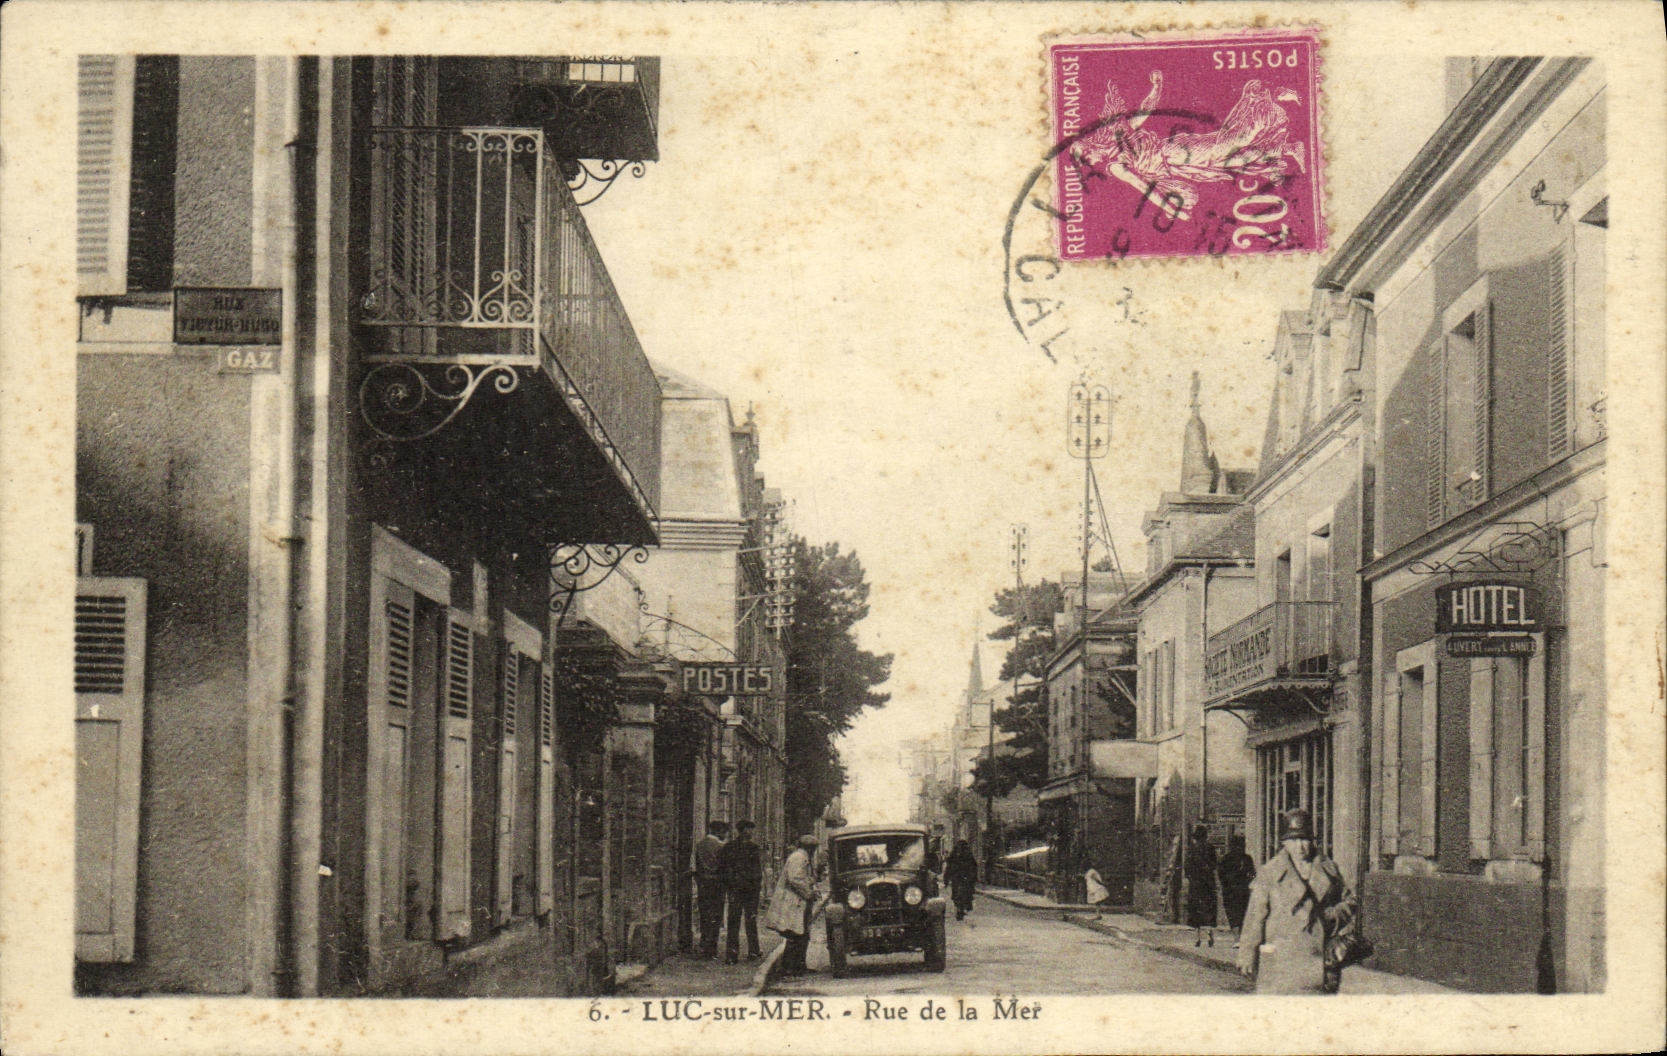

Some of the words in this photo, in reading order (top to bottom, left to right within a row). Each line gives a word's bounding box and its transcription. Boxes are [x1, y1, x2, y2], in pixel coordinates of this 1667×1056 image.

[1213, 49, 1298, 69] POSTES
[227, 350, 273, 369] GAZ
[1452, 585, 1536, 626] HOTEL
[683, 667, 772, 692] POSTES
